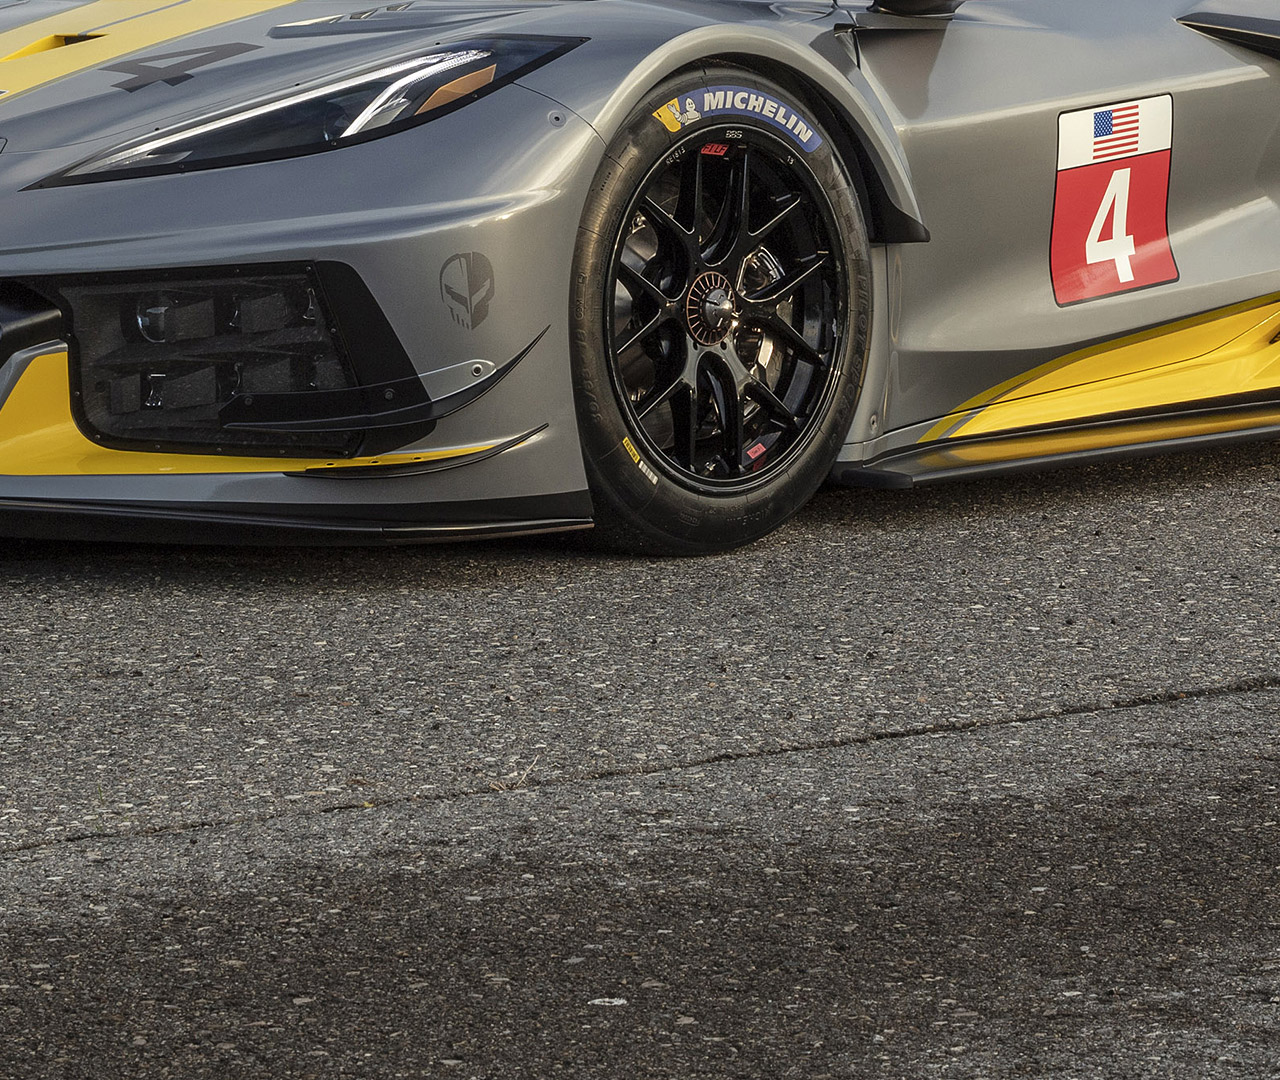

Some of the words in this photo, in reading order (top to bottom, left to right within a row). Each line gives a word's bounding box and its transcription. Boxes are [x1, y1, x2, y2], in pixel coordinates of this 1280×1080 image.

[97, 42, 265, 94] 4
[704, 91, 813, 143] MICHELIN
[1085, 167, 1136, 283] 4
